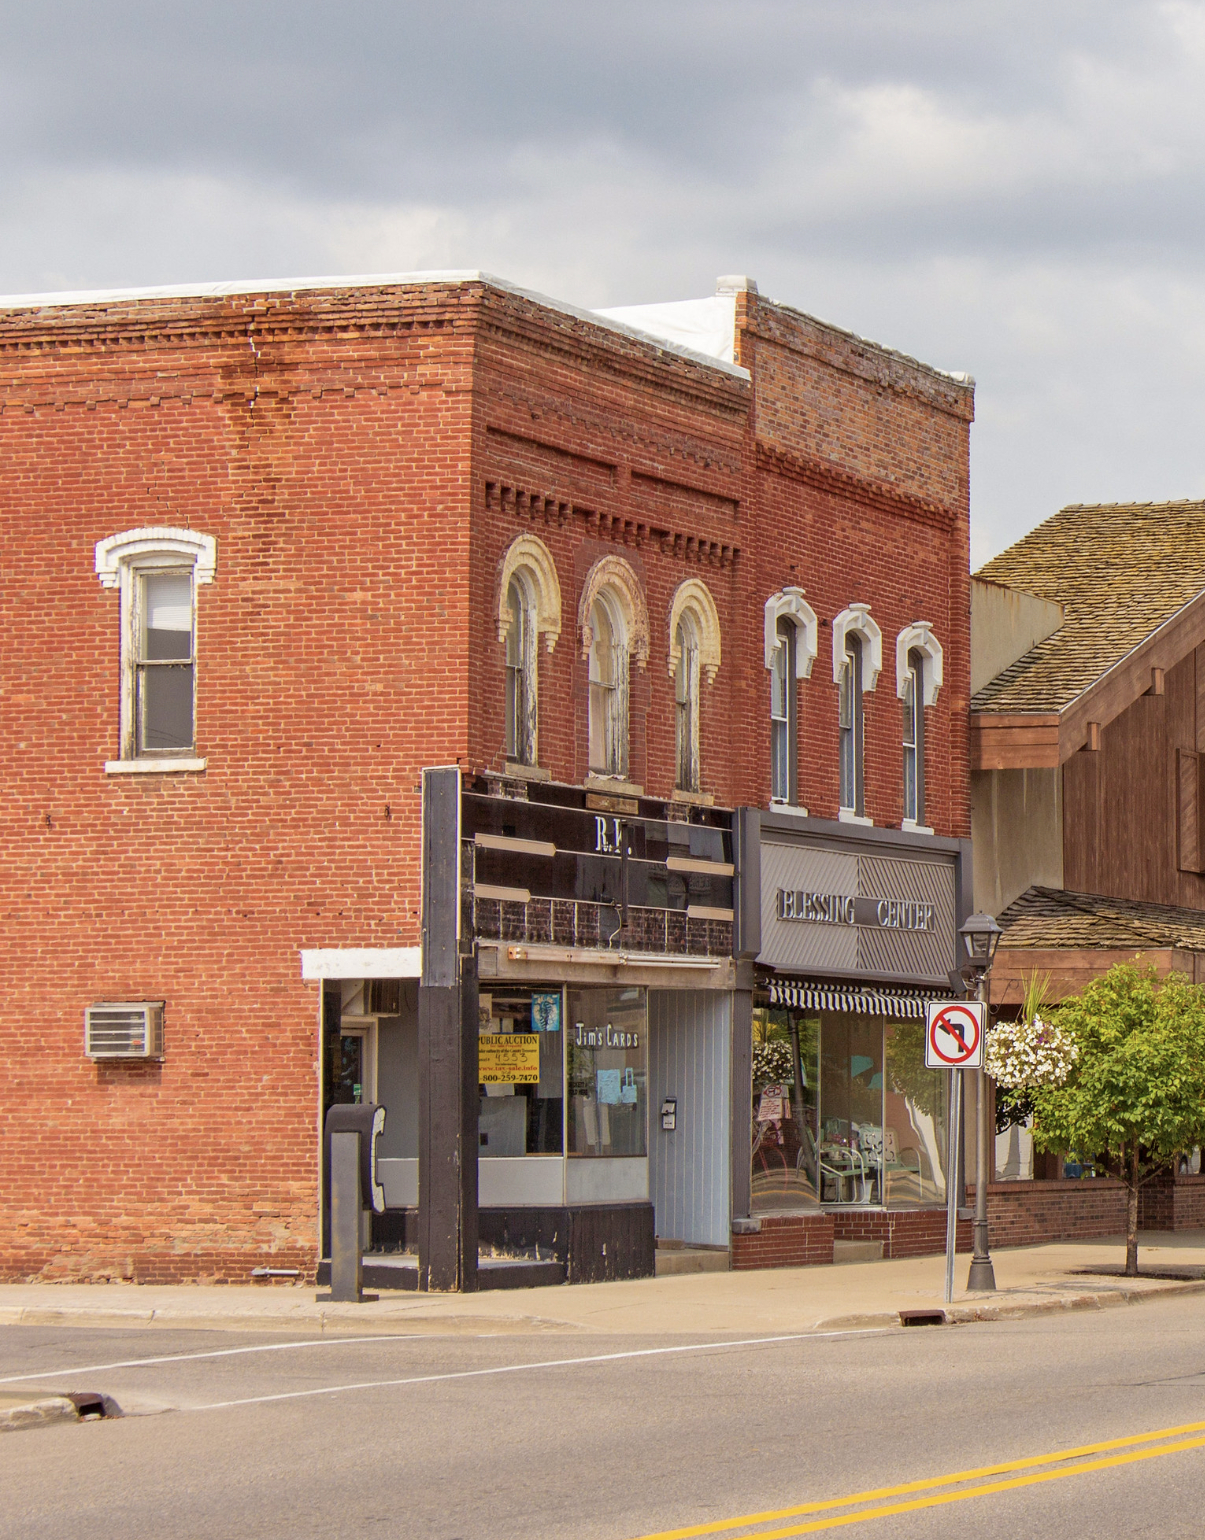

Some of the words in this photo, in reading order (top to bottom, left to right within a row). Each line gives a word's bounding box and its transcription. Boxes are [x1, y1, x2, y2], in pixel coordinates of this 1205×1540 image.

[782, 890, 856, 924] BLESSING
[877, 900, 932, 931] CENTER
[479, 1036, 503, 1044] UBLIC
[504, 1036, 537, 1044] AUCTION
[576, 1023, 602, 1045] Jim's
[480, 1074, 538, 1082] -800-259-7470
